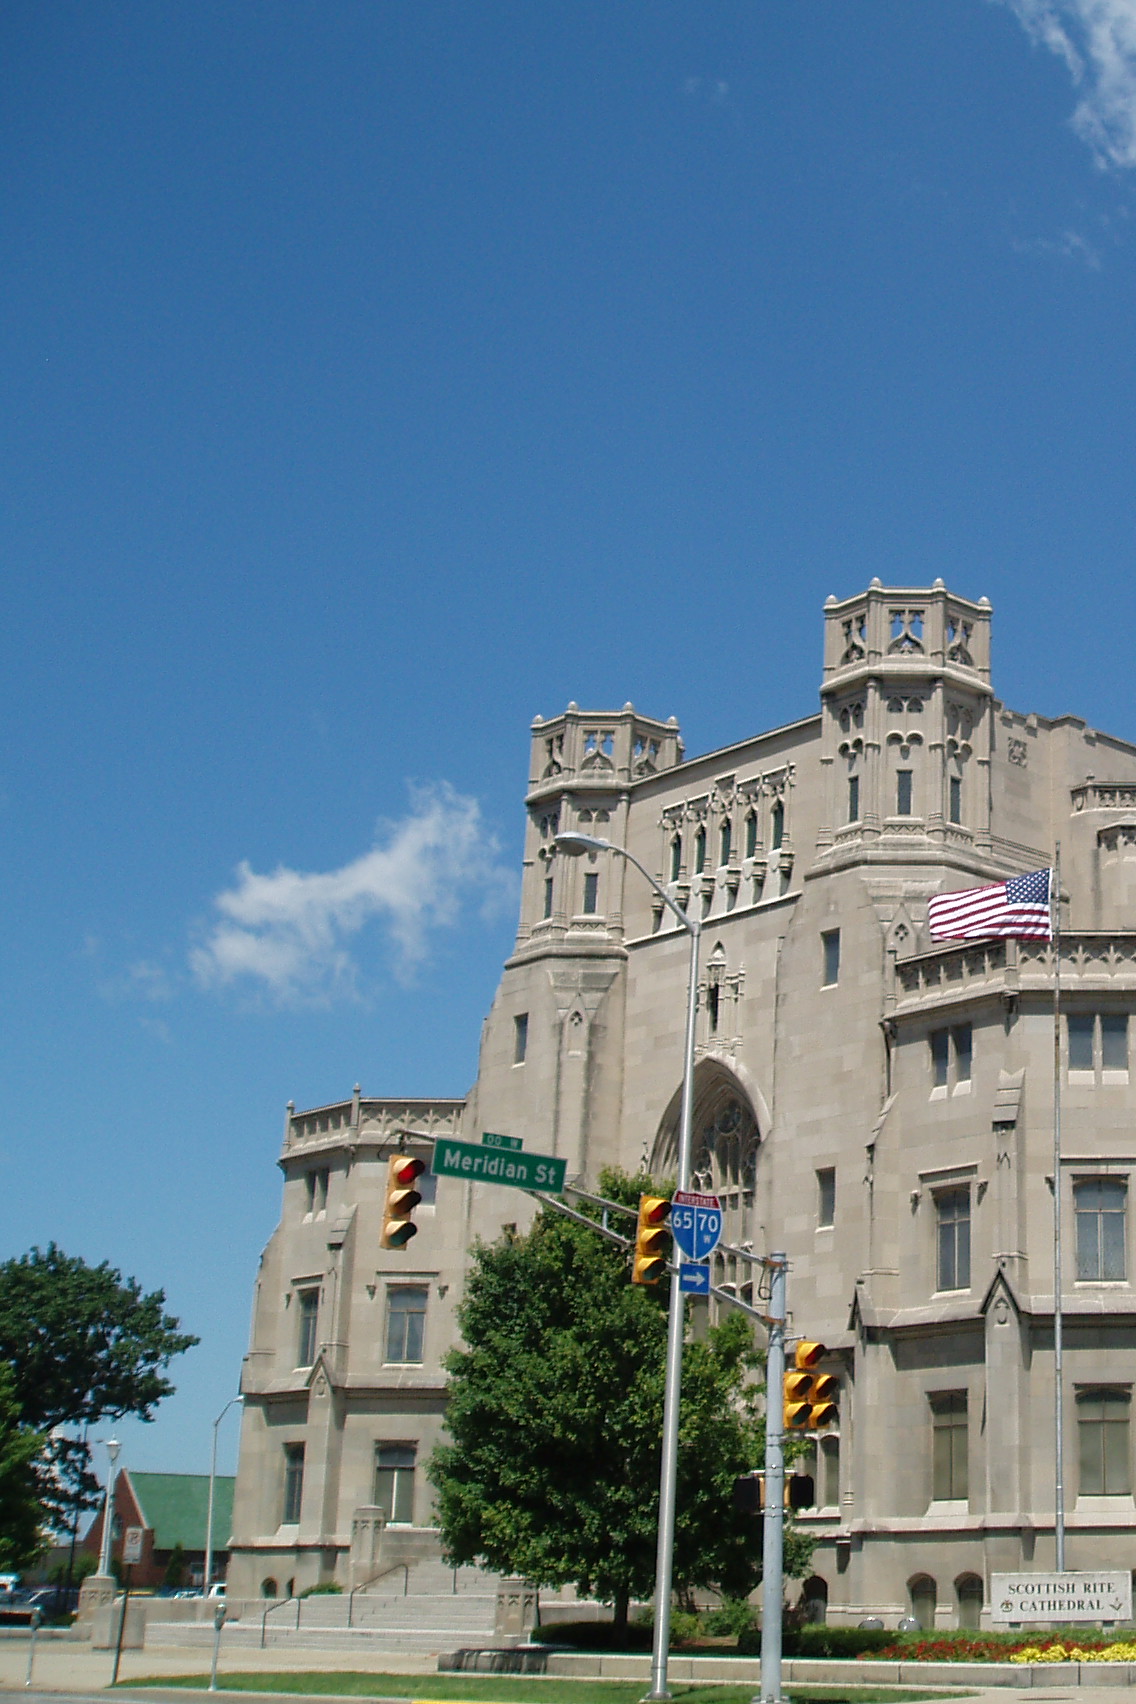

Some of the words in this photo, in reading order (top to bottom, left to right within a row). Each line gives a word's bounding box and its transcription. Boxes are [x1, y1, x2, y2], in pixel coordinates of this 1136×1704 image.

[443, 1148, 527, 1180] Meridian
[534, 1163, 557, 1185] St
[677, 1194, 715, 1208] INTERSTATE
[673, 1211, 692, 1229] 65
[697, 1213, 719, 1233] 70
[1008, 1582, 1075, 1595] SCOTTISH
[1083, 1582, 1115, 1594] RITE
[1020, 1599, 1104, 1612] CATHEDRAL
